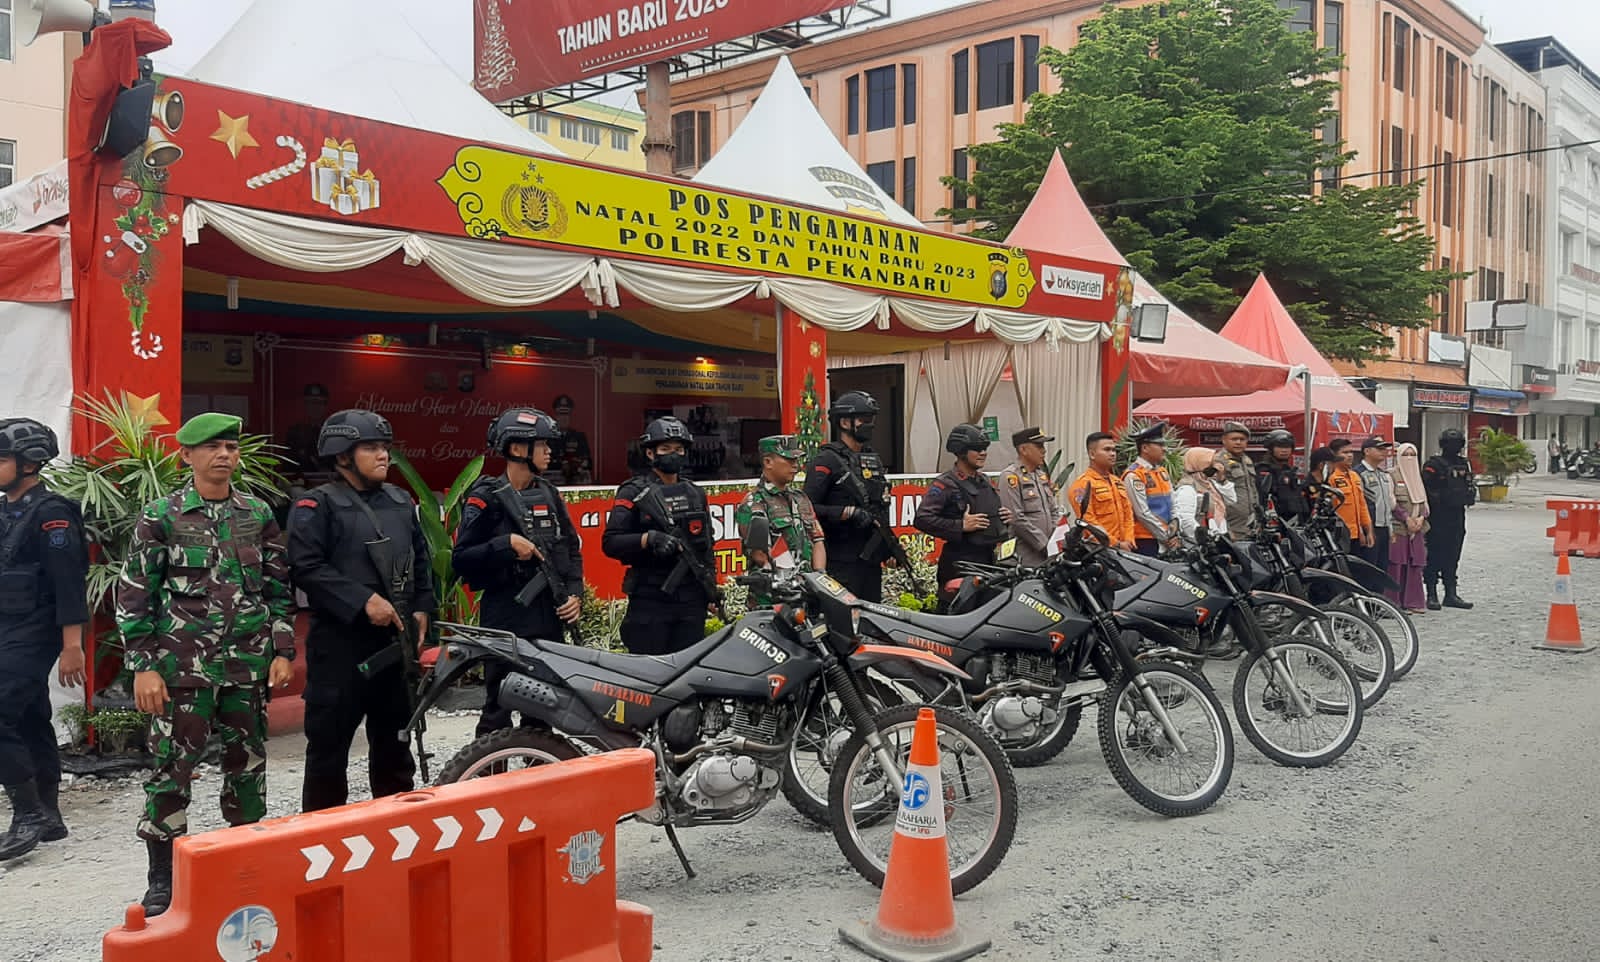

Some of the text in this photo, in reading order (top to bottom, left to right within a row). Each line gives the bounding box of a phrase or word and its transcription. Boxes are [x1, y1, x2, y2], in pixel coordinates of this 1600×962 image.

[557, 14, 611, 55] TAHUN
[617, 0, 667, 37] BARU
[668, 188, 919, 254] POS PENGAMANAN
[575, 200, 976, 280] NATAL 2022 DAN TAHUN BARU 2023
[619, 227, 951, 293] POLRESTA PEKANBARU
[1057, 275, 1101, 295] brksyariah
[1167, 574, 1206, 599] BRIMOB
[1018, 593, 1062, 622] BRIMOB
[739, 627, 787, 664] BRIMOB
[603, 699, 625, 724] A
